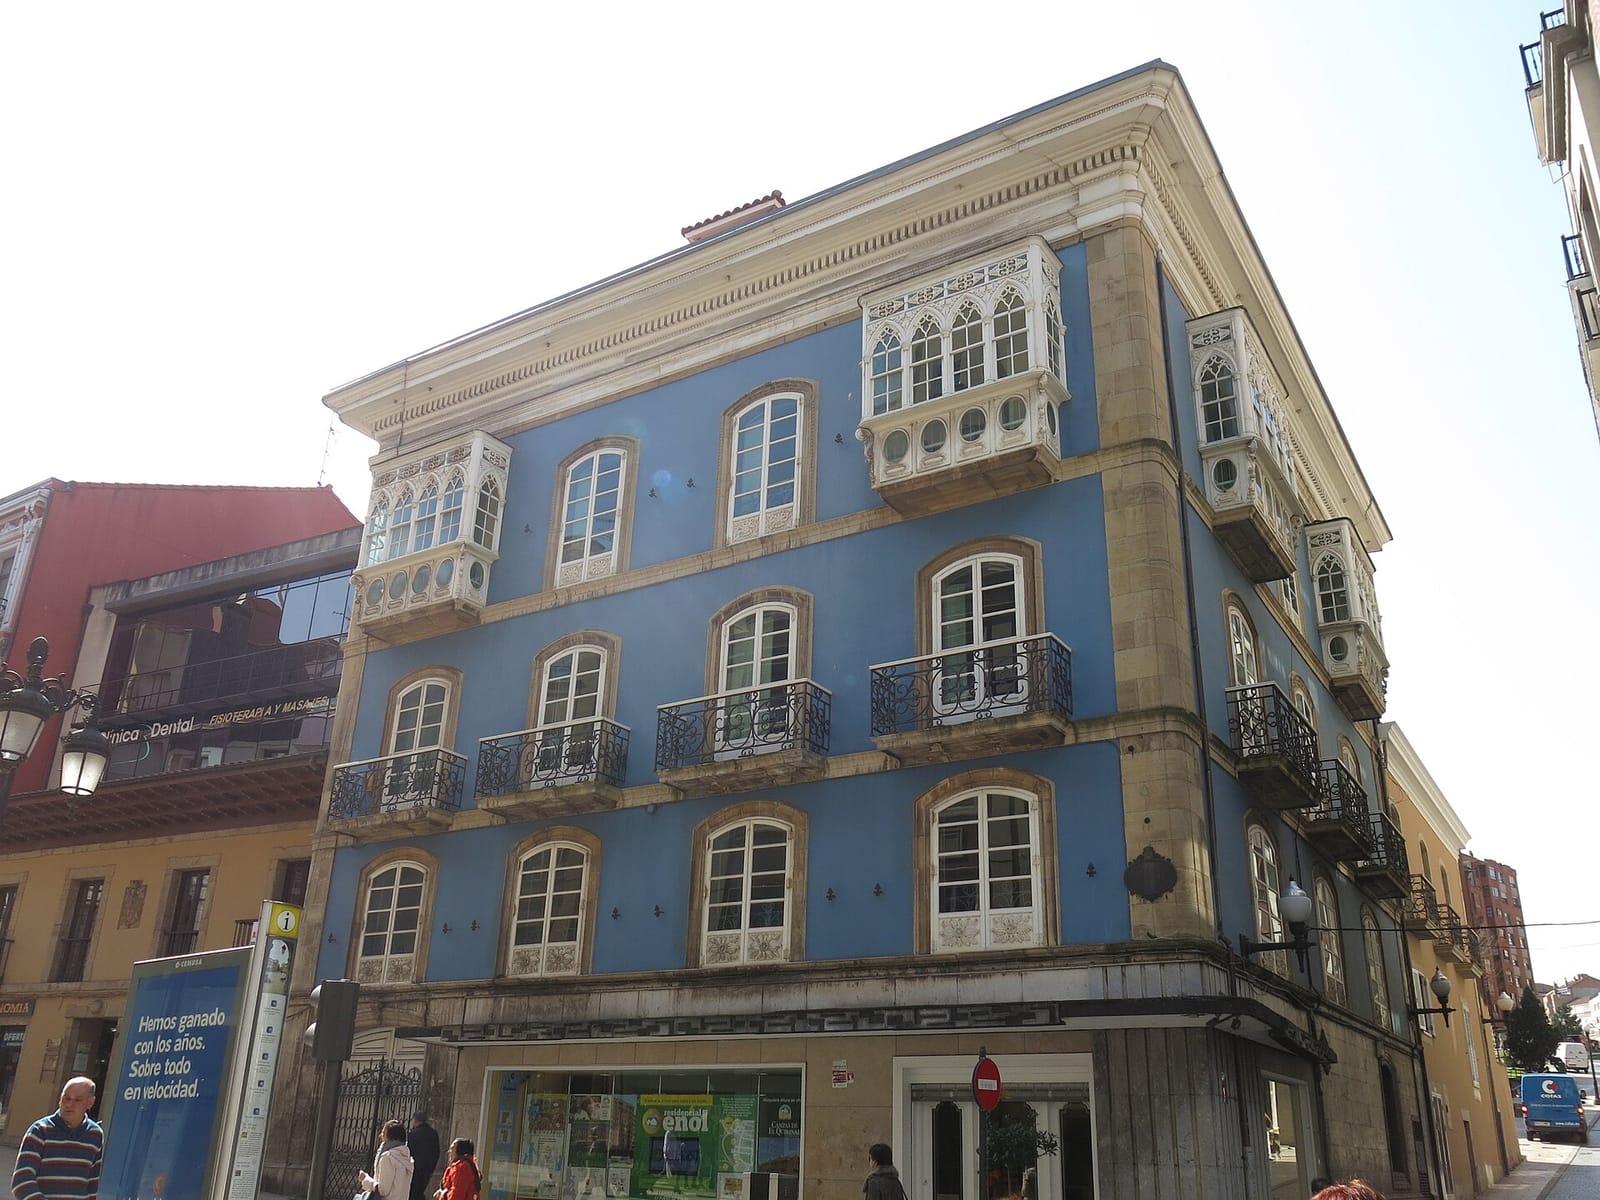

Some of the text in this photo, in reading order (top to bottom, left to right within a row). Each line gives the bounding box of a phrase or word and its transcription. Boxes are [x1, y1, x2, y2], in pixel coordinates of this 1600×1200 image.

[150, 717, 194, 738] Dental
[138, 1007, 225, 1034] Hemos ganado
[134, 1033, 206, 1055] con los años.
[128, 1055, 191, 1078] Sobre todo
[123, 1078, 200, 1101] en velocidad.
[662, 1109, 708, 1132] enol
